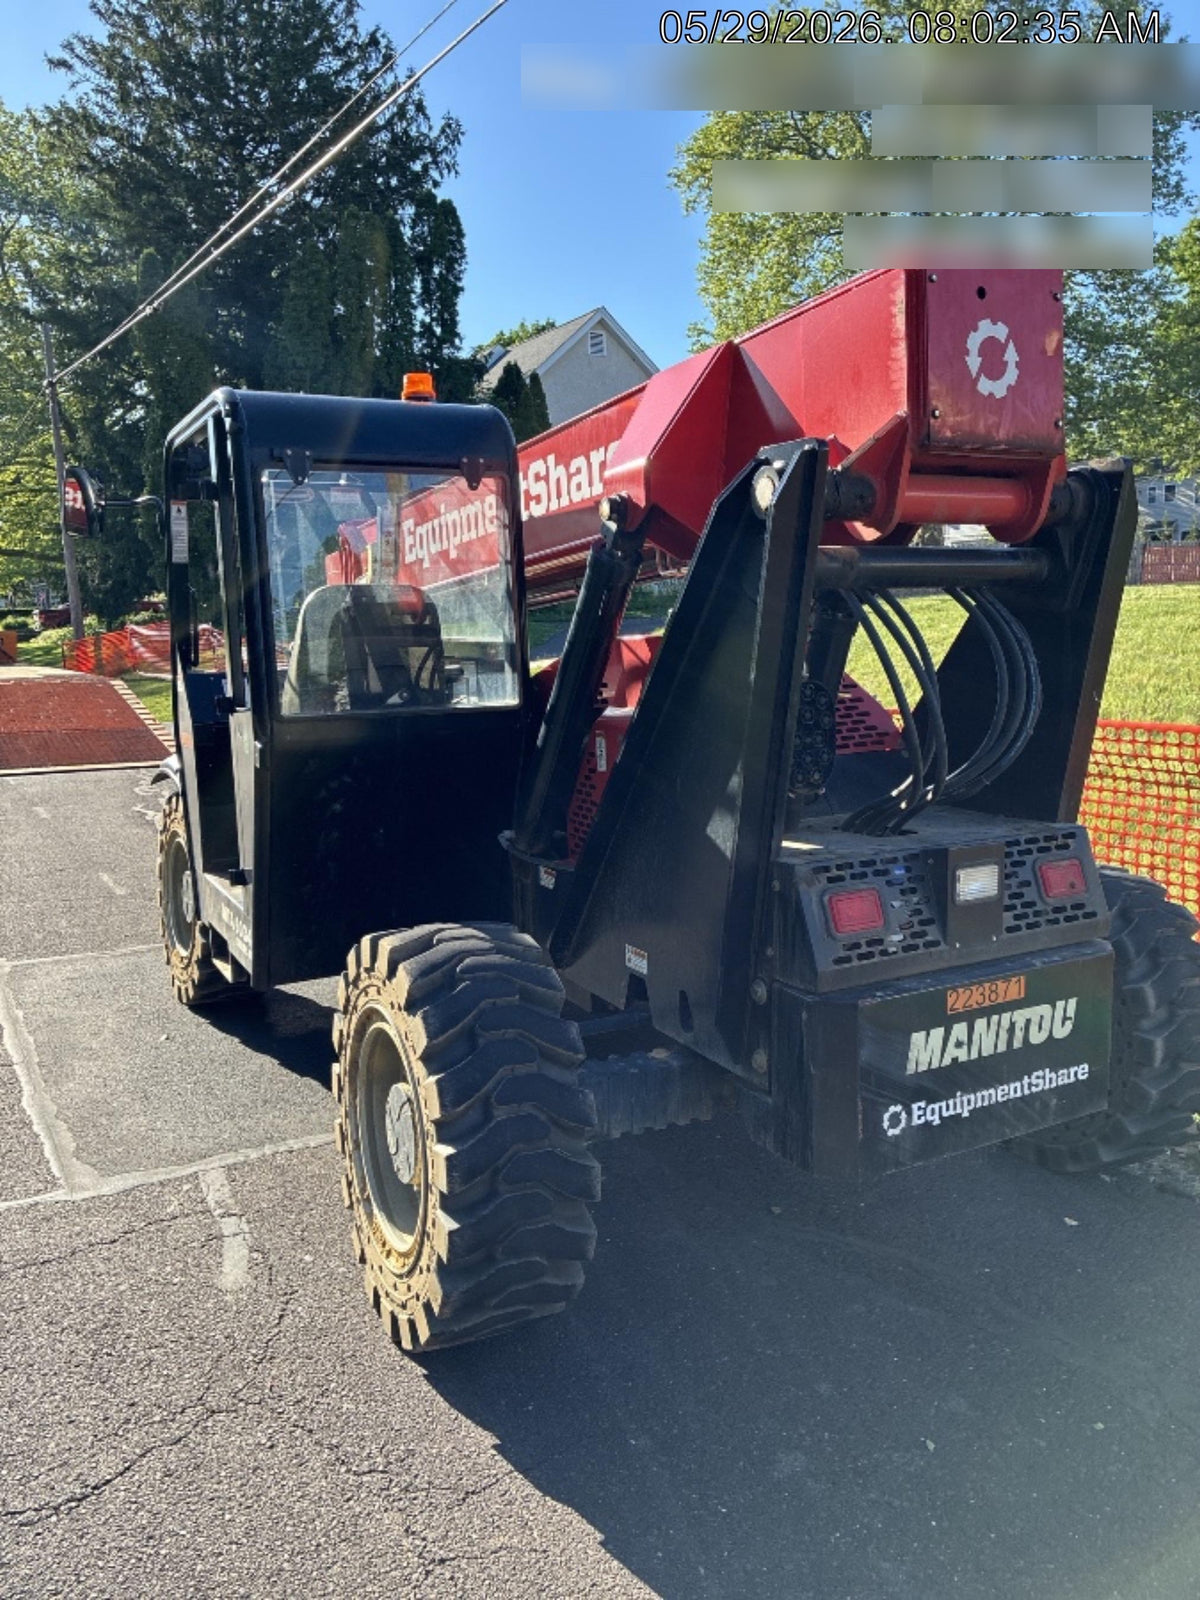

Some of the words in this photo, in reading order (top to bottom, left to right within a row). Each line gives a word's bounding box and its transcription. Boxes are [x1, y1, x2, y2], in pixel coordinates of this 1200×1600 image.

[949, 976, 1025, 1012] 223871
[905, 996, 1078, 1076] MANITOU
[910, 1062, 1090, 1126] EquipmentShare
